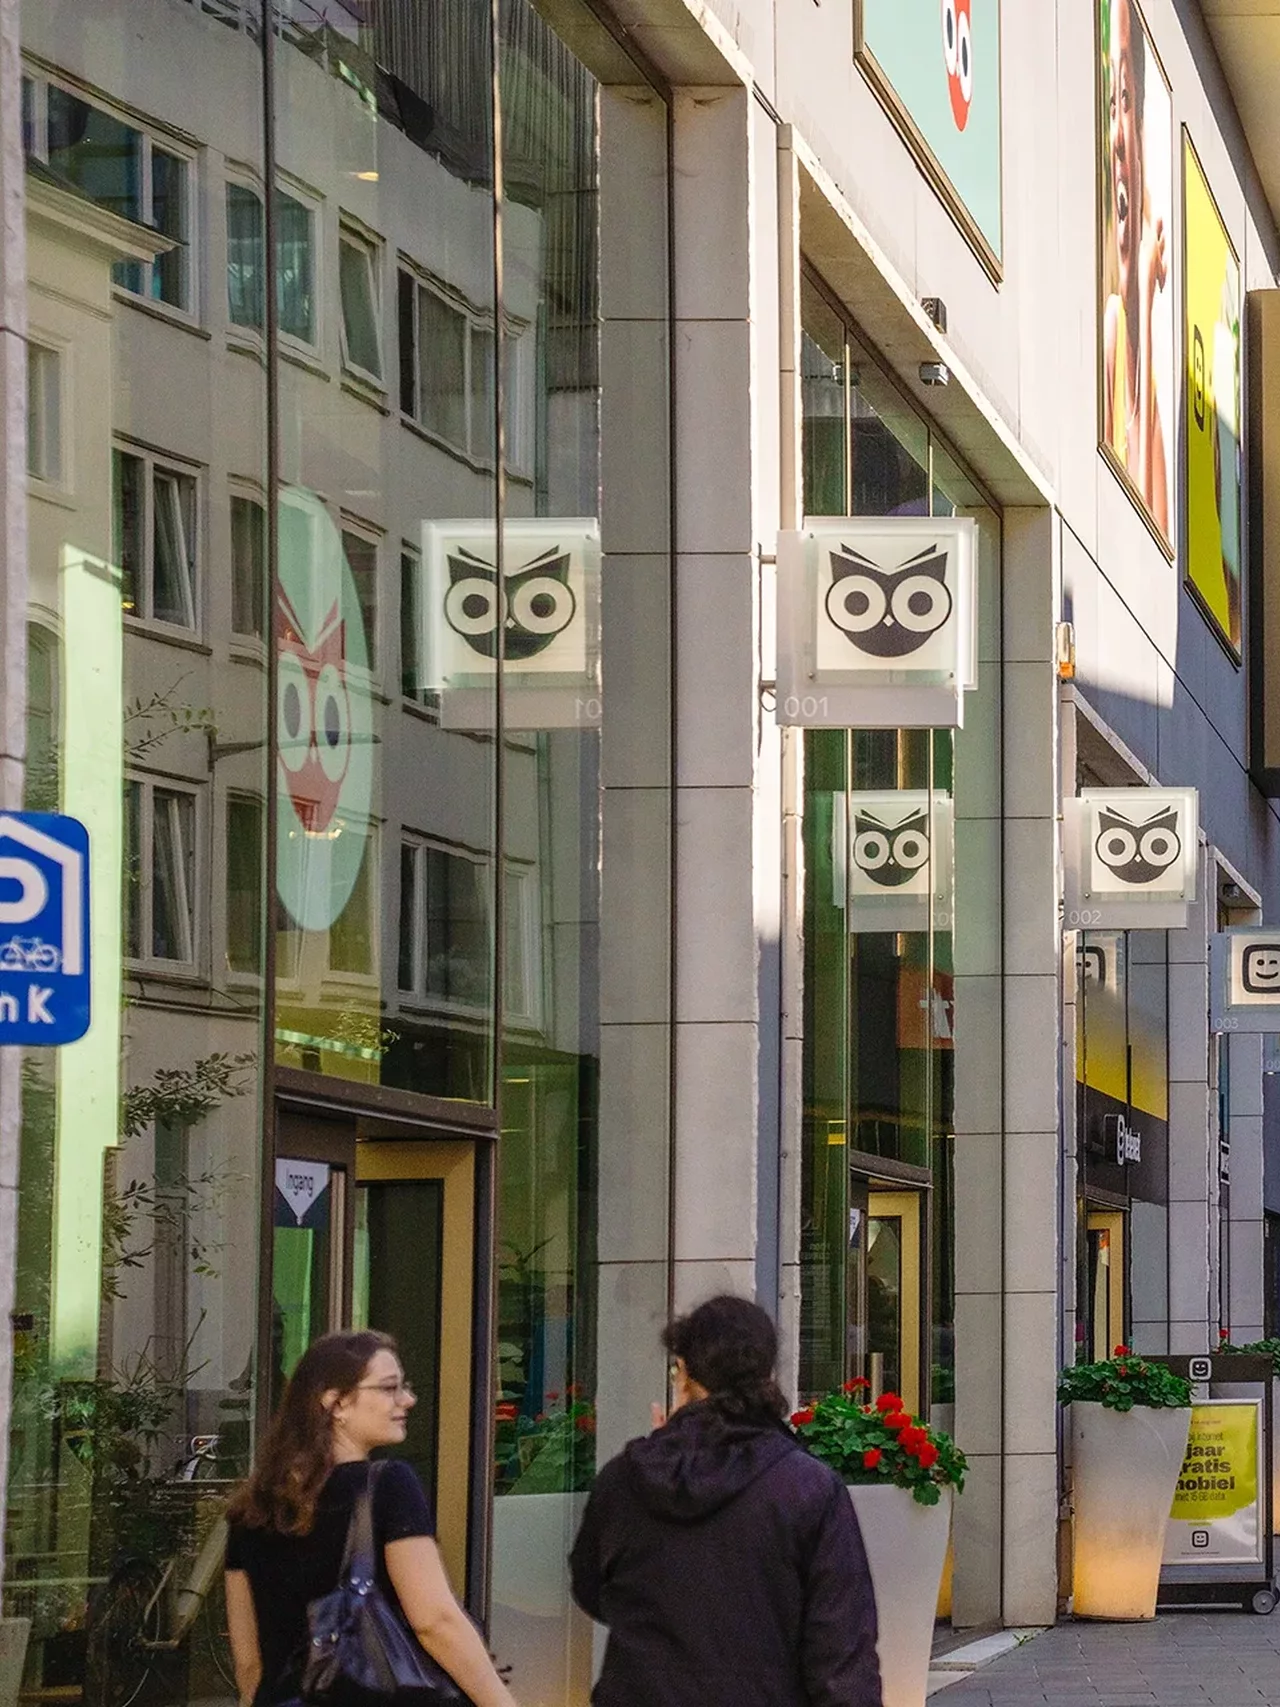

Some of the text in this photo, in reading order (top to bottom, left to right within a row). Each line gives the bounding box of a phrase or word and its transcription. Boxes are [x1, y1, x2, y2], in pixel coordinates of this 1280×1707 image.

[784, 696, 829, 718] 001
[1069, 910, 1102, 925] 002
[27, 983, 56, 1024] K
[1214, 1017, 1239, 1029] 003
[286, 1167, 314, 1198] Ingang
[1186, 1443, 1226, 1460] jaar
[1178, 1458, 1232, 1477] ratis
